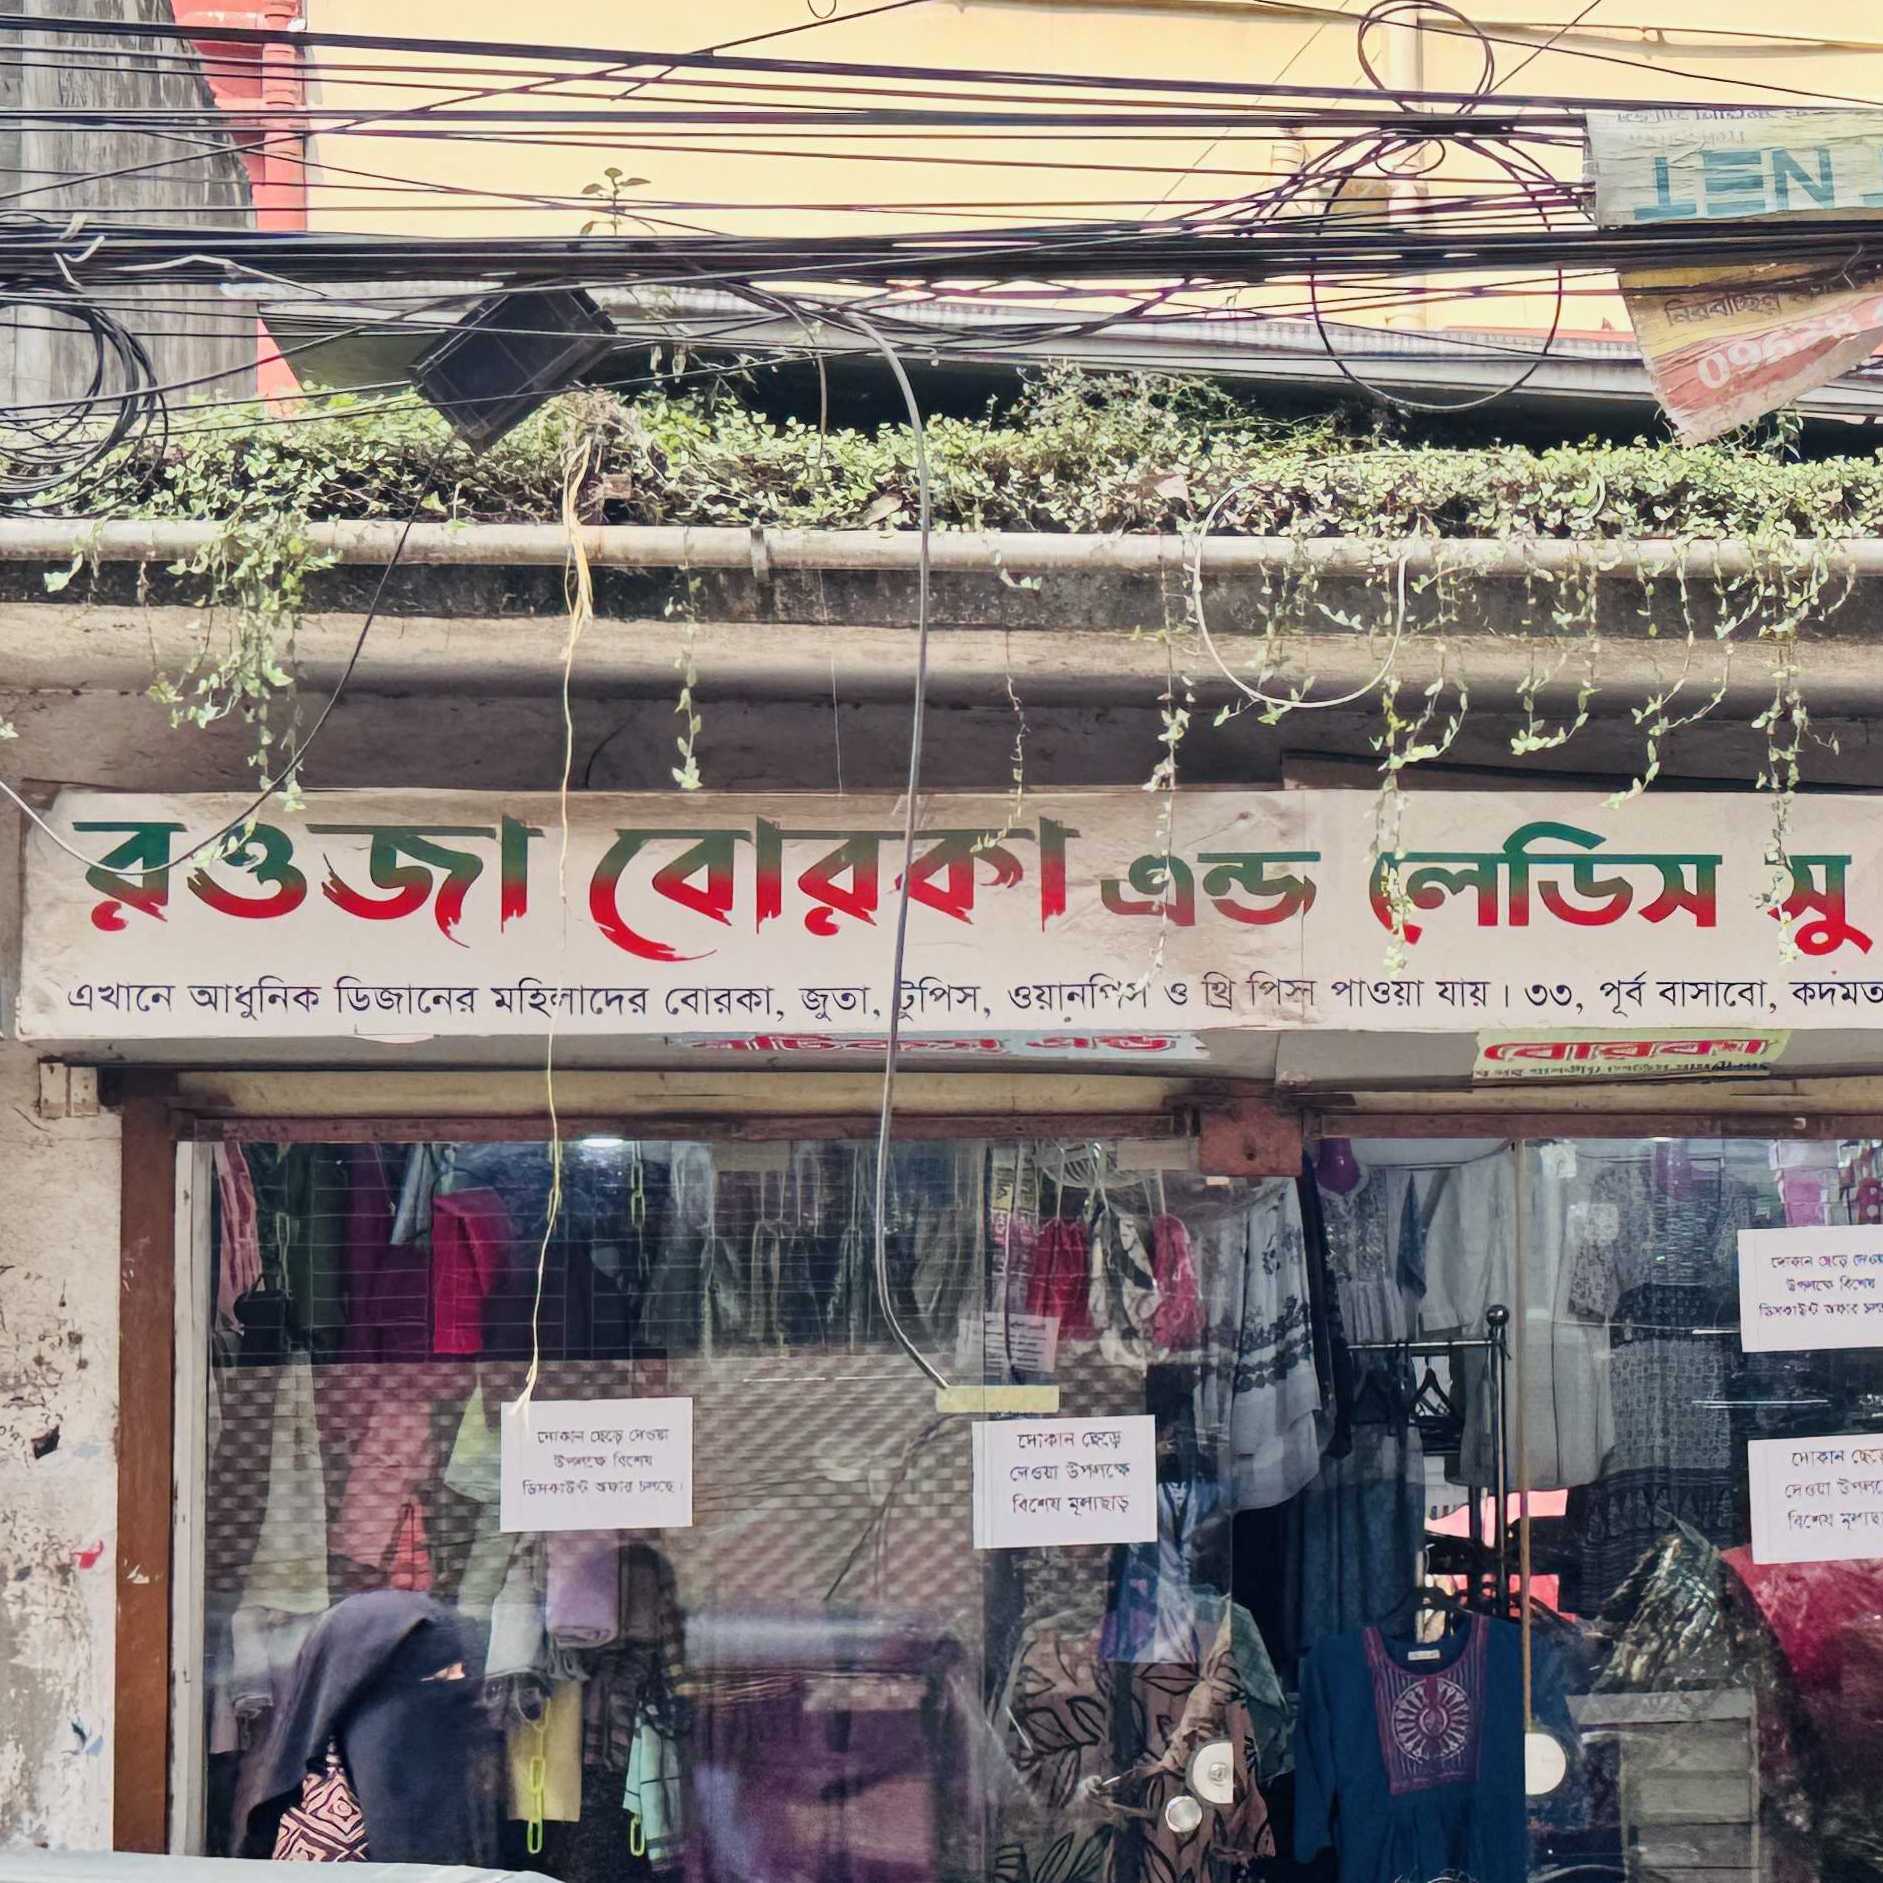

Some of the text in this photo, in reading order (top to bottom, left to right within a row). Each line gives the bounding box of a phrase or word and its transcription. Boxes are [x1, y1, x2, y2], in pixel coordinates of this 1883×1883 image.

[72, 814, 1873, 962] রওজা বোরকা এন্ড লেডিস সু
[68, 982, 175, 1012] এখানে
[187, 975, 321, 1020] আধুনিক
[333, 976, 479, 1014] ডিজানের
[490, 977, 649, 1017] মহিলাদের
[666, 986, 784, 1021] বোরকা,
[799, 986, 880, 1021] জুতা,
[1164, 983, 1187, 1006] ও
[1201, 971, 1236, 1010] থ্রি
[1245, 971, 1317, 1007] পিস
[1331, 979, 1424, 1007] পাওয়া
[1435, 981, 1491, 1008] যায়
[1524, 984, 1583, 1014] ৩৩,
[1600, 971, 1647, 1017] পূর্ব
[1656, 980, 1776, 1014] বাসাবো,
[1017, 1432, 1074, 1449] দোকান
